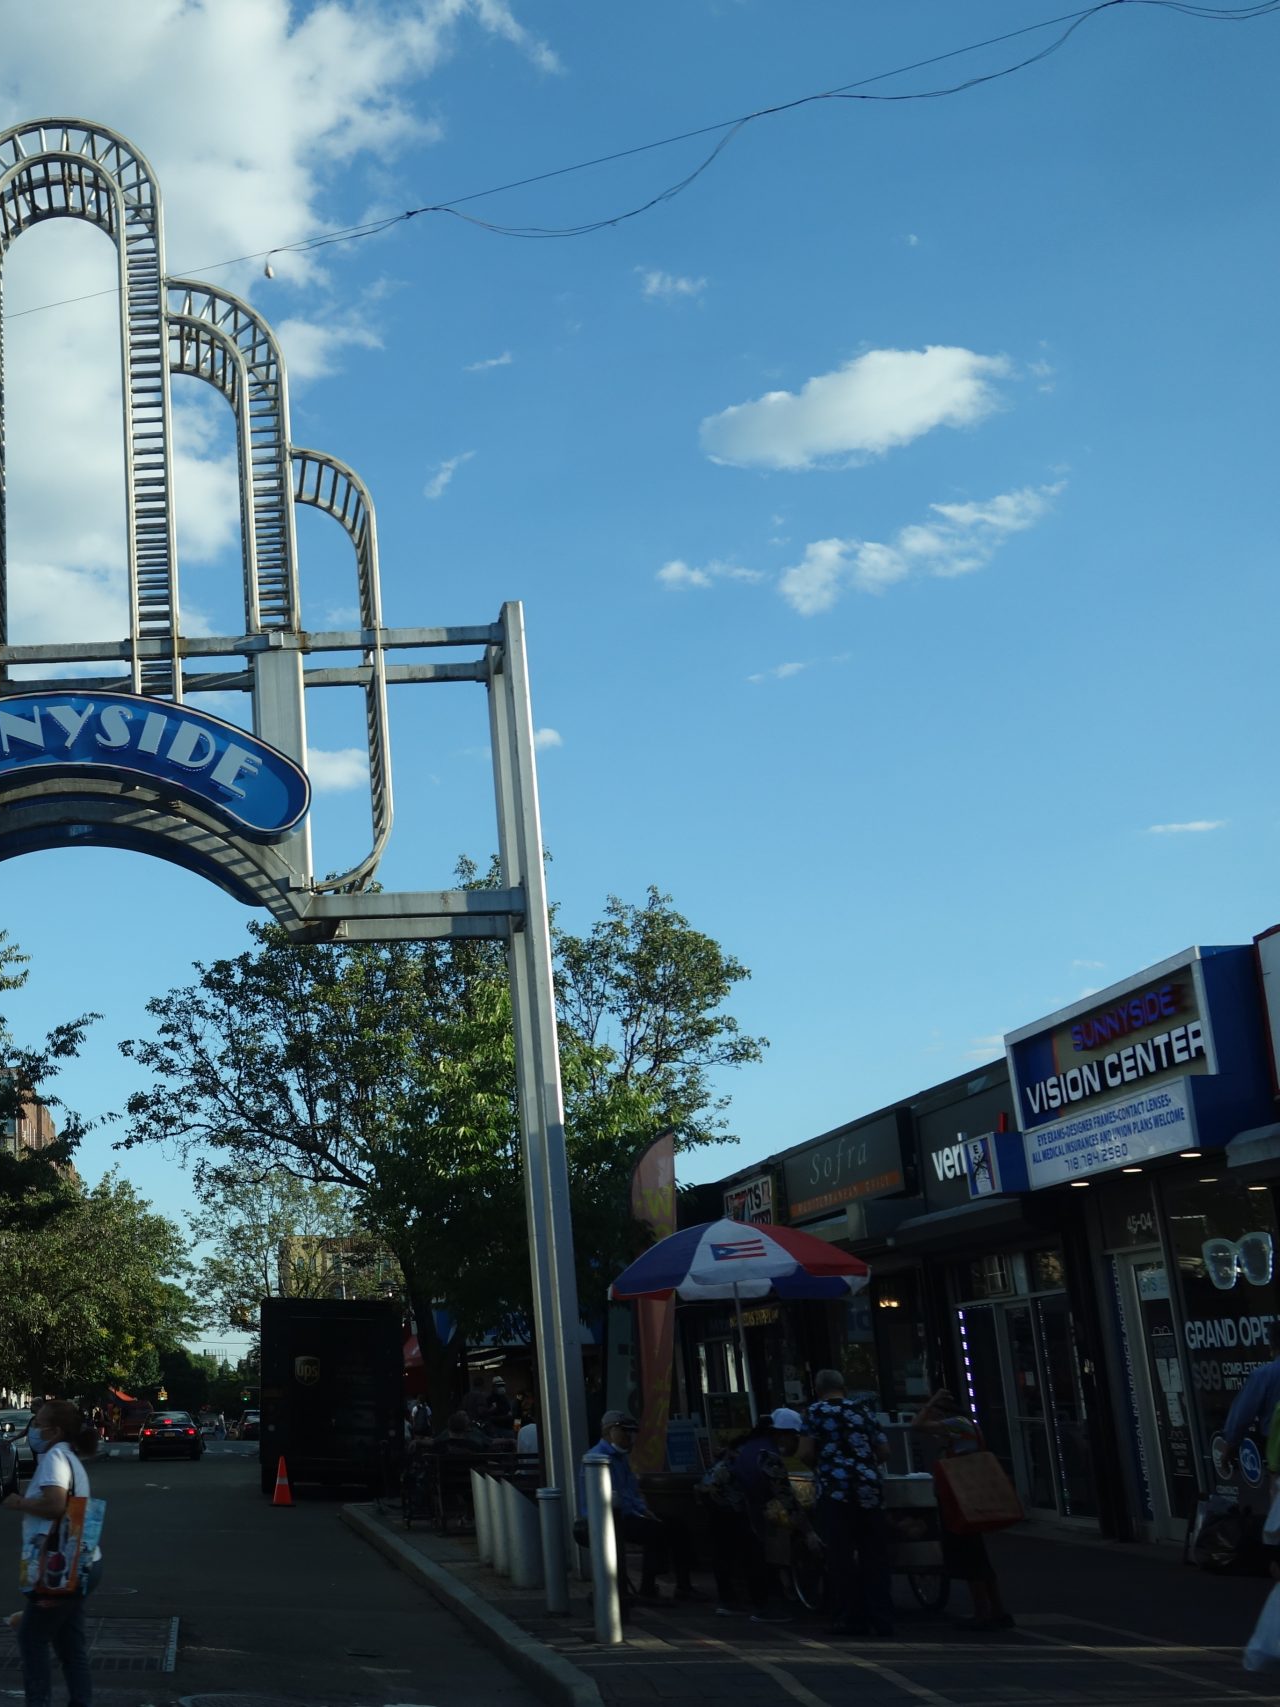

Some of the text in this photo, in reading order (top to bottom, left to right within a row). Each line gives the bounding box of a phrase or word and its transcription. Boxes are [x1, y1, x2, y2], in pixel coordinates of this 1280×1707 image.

[1070, 984, 1176, 1052] SUNNYSIDE
[1025, 1019, 1207, 1114] VISION CENTER
[931, 1132, 967, 1182] veri
[1042, 1145, 1065, 1162] MEDICAL
[1065, 1134, 1099, 1156] INSURANCES
[1099, 1131, 1112, 1144] AND
[1133, 1116, 1153, 1134] PLANS
[1154, 1107, 1185, 1129] WELCOME
[810, 1138, 867, 1185] Sofra
[1184, 1318, 1238, 1350] GRAND
[1238, 1316, 1271, 1347] OPE
